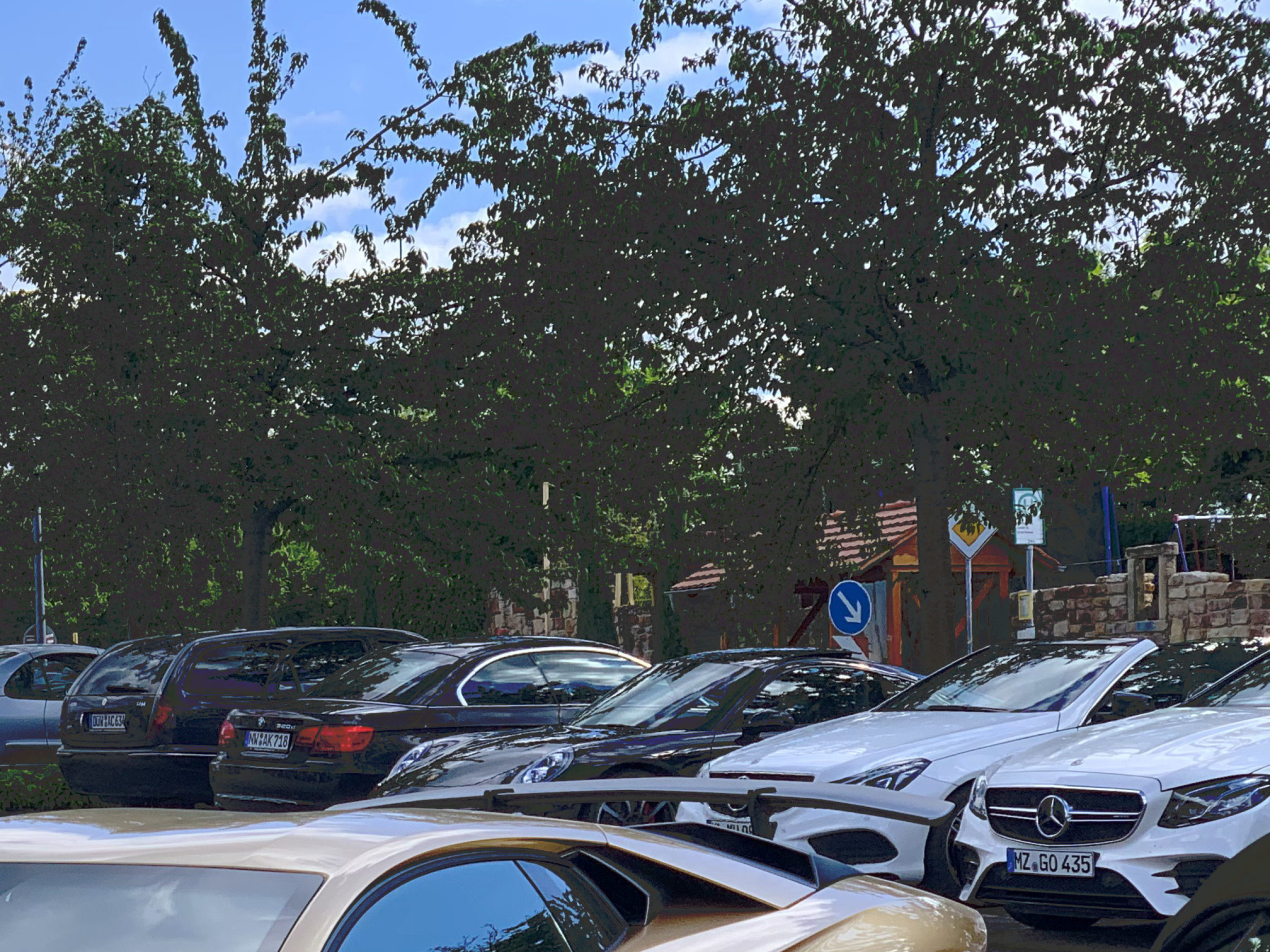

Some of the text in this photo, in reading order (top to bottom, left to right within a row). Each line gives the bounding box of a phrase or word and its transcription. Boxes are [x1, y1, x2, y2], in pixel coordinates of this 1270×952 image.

[263, 734, 273, 747] AK
[274, 735, 288, 747] 718
[1014, 852, 1090, 873] MZ GO 435
